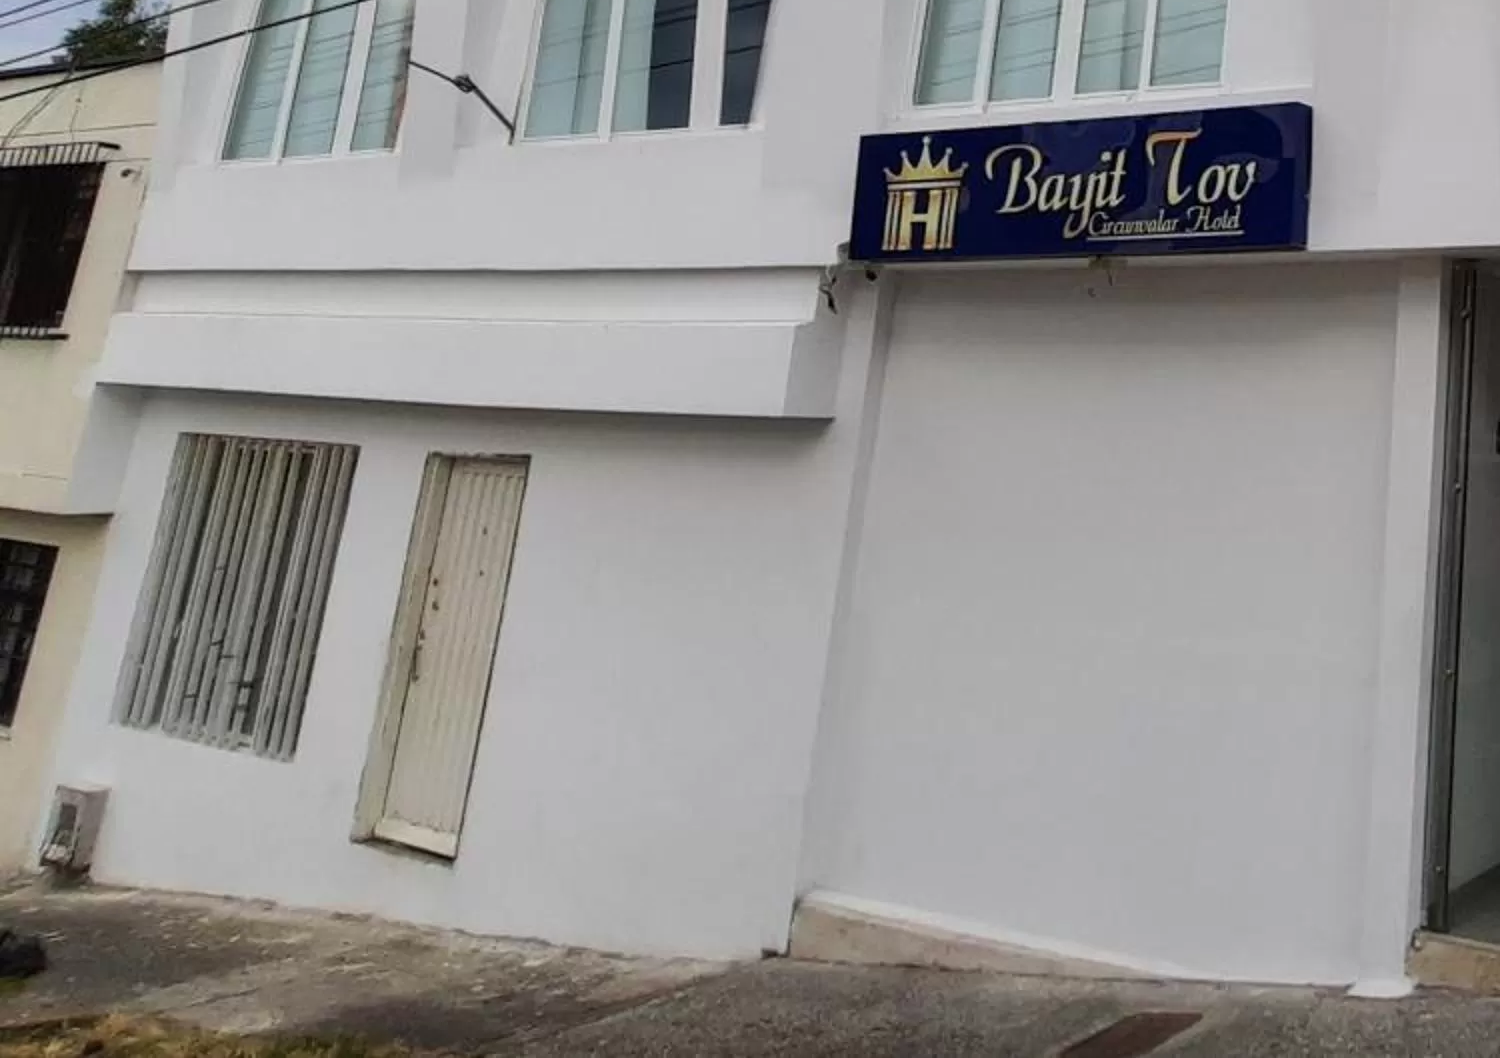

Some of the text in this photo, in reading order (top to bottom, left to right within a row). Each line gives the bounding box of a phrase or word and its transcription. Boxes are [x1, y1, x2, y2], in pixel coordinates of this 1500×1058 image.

[984, 127, 1258, 239] Bayit Tov
[1185, 204, 1243, 233] Hotel
